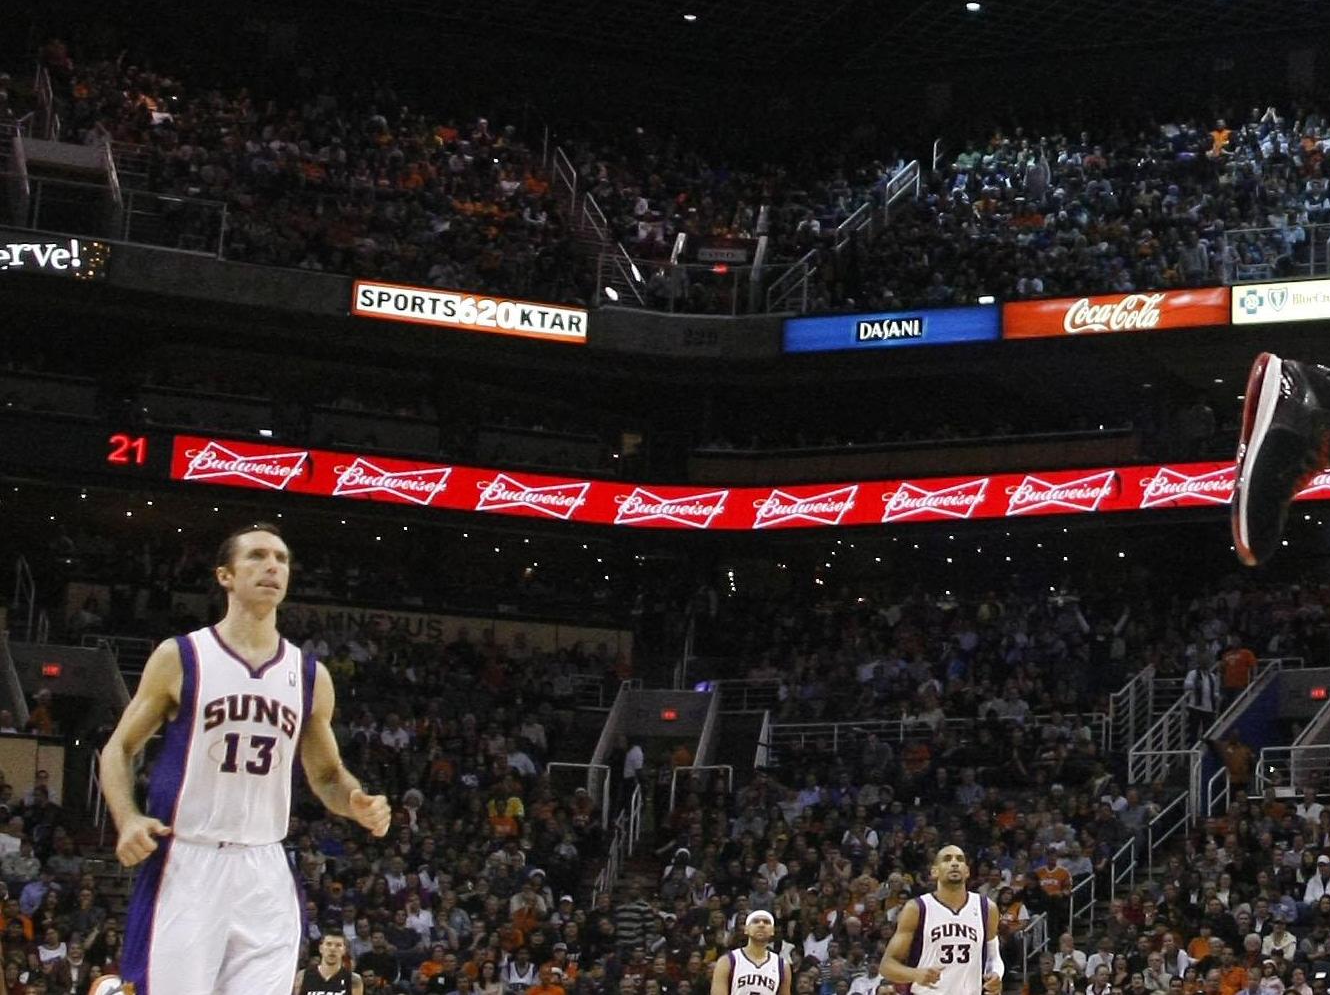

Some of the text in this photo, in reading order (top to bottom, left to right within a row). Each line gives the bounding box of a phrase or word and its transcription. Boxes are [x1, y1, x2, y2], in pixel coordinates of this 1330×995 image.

[361, 289, 582, 333] SPORTS 620 KTAR
[859, 318, 922, 341] DASANI
[106, 434, 147, 466] 21
[185, 448, 303, 480] Budweiser
[334, 464, 447, 496] Budweiser
[1006, 479, 1113, 504] Budweiser
[1140, 473, 1235, 497] Budweise
[477, 481, 587, 509] Budweiser
[614, 494, 725, 518] Budweiser
[753, 492, 855, 517] Budweiser
[882, 486, 986, 511] Budweiser
[203, 694, 296, 739] SUNS
[220, 732, 278, 775] 13
[930, 923, 978, 943] SUNS
[939, 943, 971, 965] 33
[737, 973, 775, 992] SUNS
